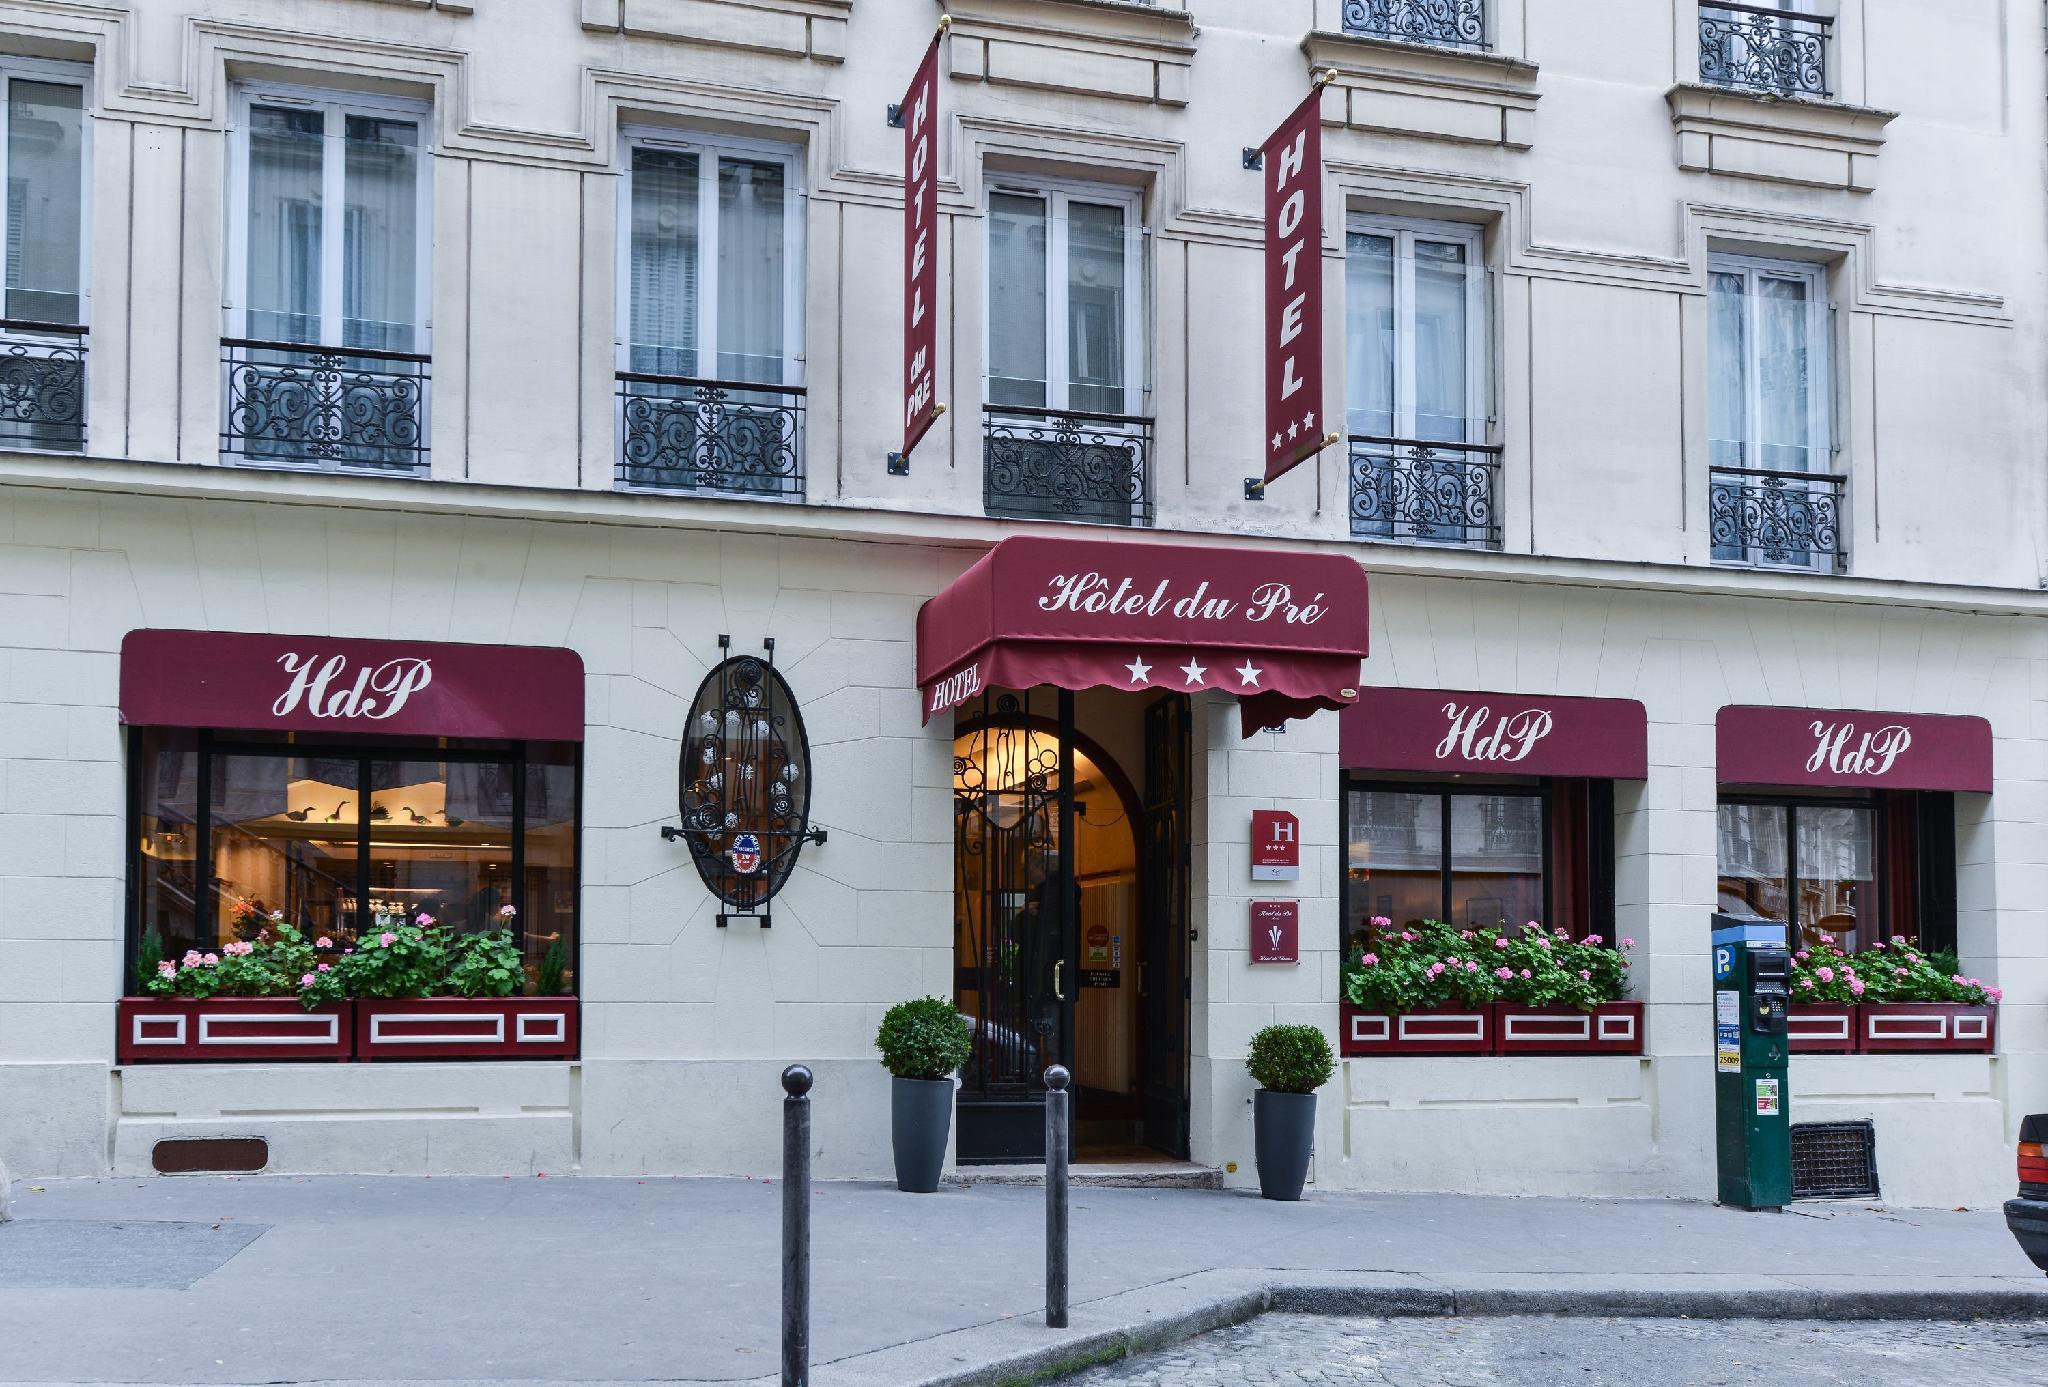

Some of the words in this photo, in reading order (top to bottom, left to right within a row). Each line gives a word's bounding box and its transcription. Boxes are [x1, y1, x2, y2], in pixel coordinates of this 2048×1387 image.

[911, 79, 929, 329] HOTEL
[1276, 128, 1306, 401] HOTEL
[911, 344, 927, 384] du
[1038, 572, 1171, 617] Hôtel
[1173, 581, 1239, 620] du
[1246, 582, 1329, 625] Pré
[272, 652, 432, 719] HdP
[930, 662, 981, 712] HOTEL
[1435, 702, 1553, 762] HdP
[1806, 720, 1912, 775] HdP
[1271, 821, 1295, 842] H
[1719, 1056, 1740, 1065] 75009
